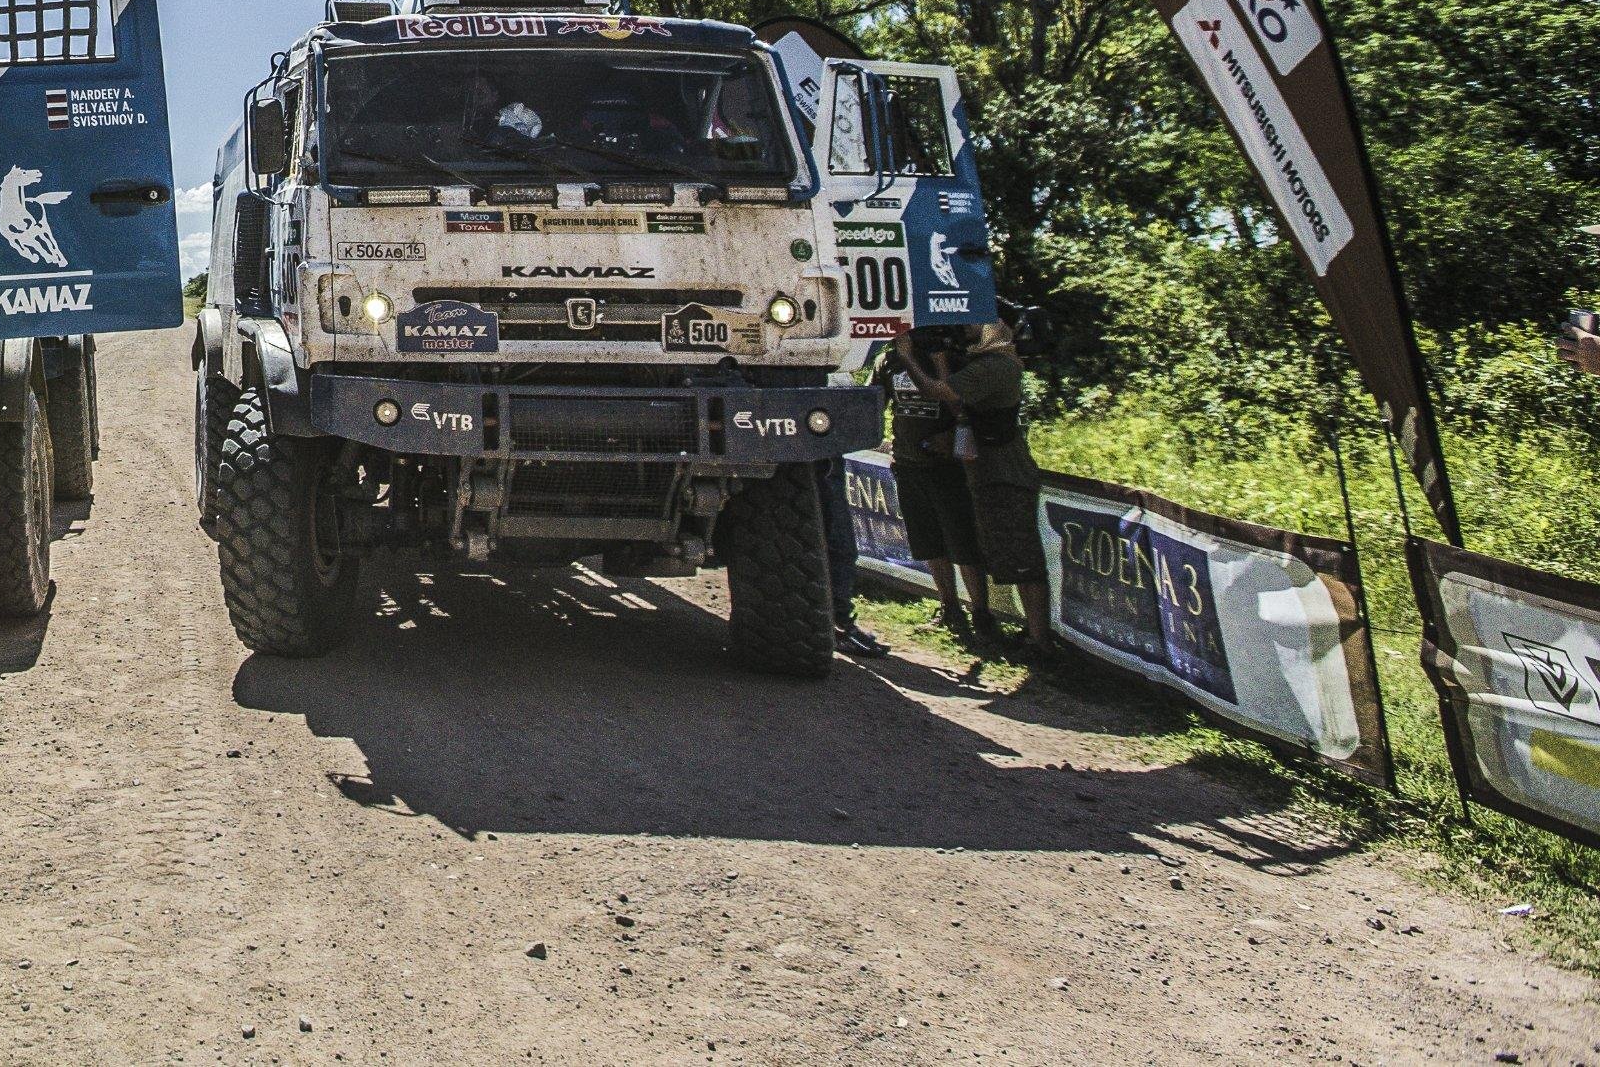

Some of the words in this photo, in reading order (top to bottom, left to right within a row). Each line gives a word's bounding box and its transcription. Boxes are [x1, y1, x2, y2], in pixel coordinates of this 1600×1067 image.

[396, 16, 471, 39] Red
[474, 15, 547, 38] Bull
[70, 88, 120, 101] MARDEEV
[72, 101, 118, 114] BELYAEV
[73, 113, 134, 128] SVISTUNOV
[1222, 49, 1287, 163] MITSUBISHI
[1282, 160, 1331, 243] MOTORS
[460, 213, 490, 221] Macro
[834, 226, 896, 243] peedAgro
[502, 266, 655, 279] KAMAZ
[929, 297, 970, 313] KAMAZ
[424, 303, 468, 324] Team
[404, 325, 487, 337] KAMAZ
[692, 323, 728, 342] 500
[422, 338, 475, 349] master
[433, 413, 473, 432] VTB
[755, 419, 797, 436] VTB
[1183, 564, 1203, 616] 3
